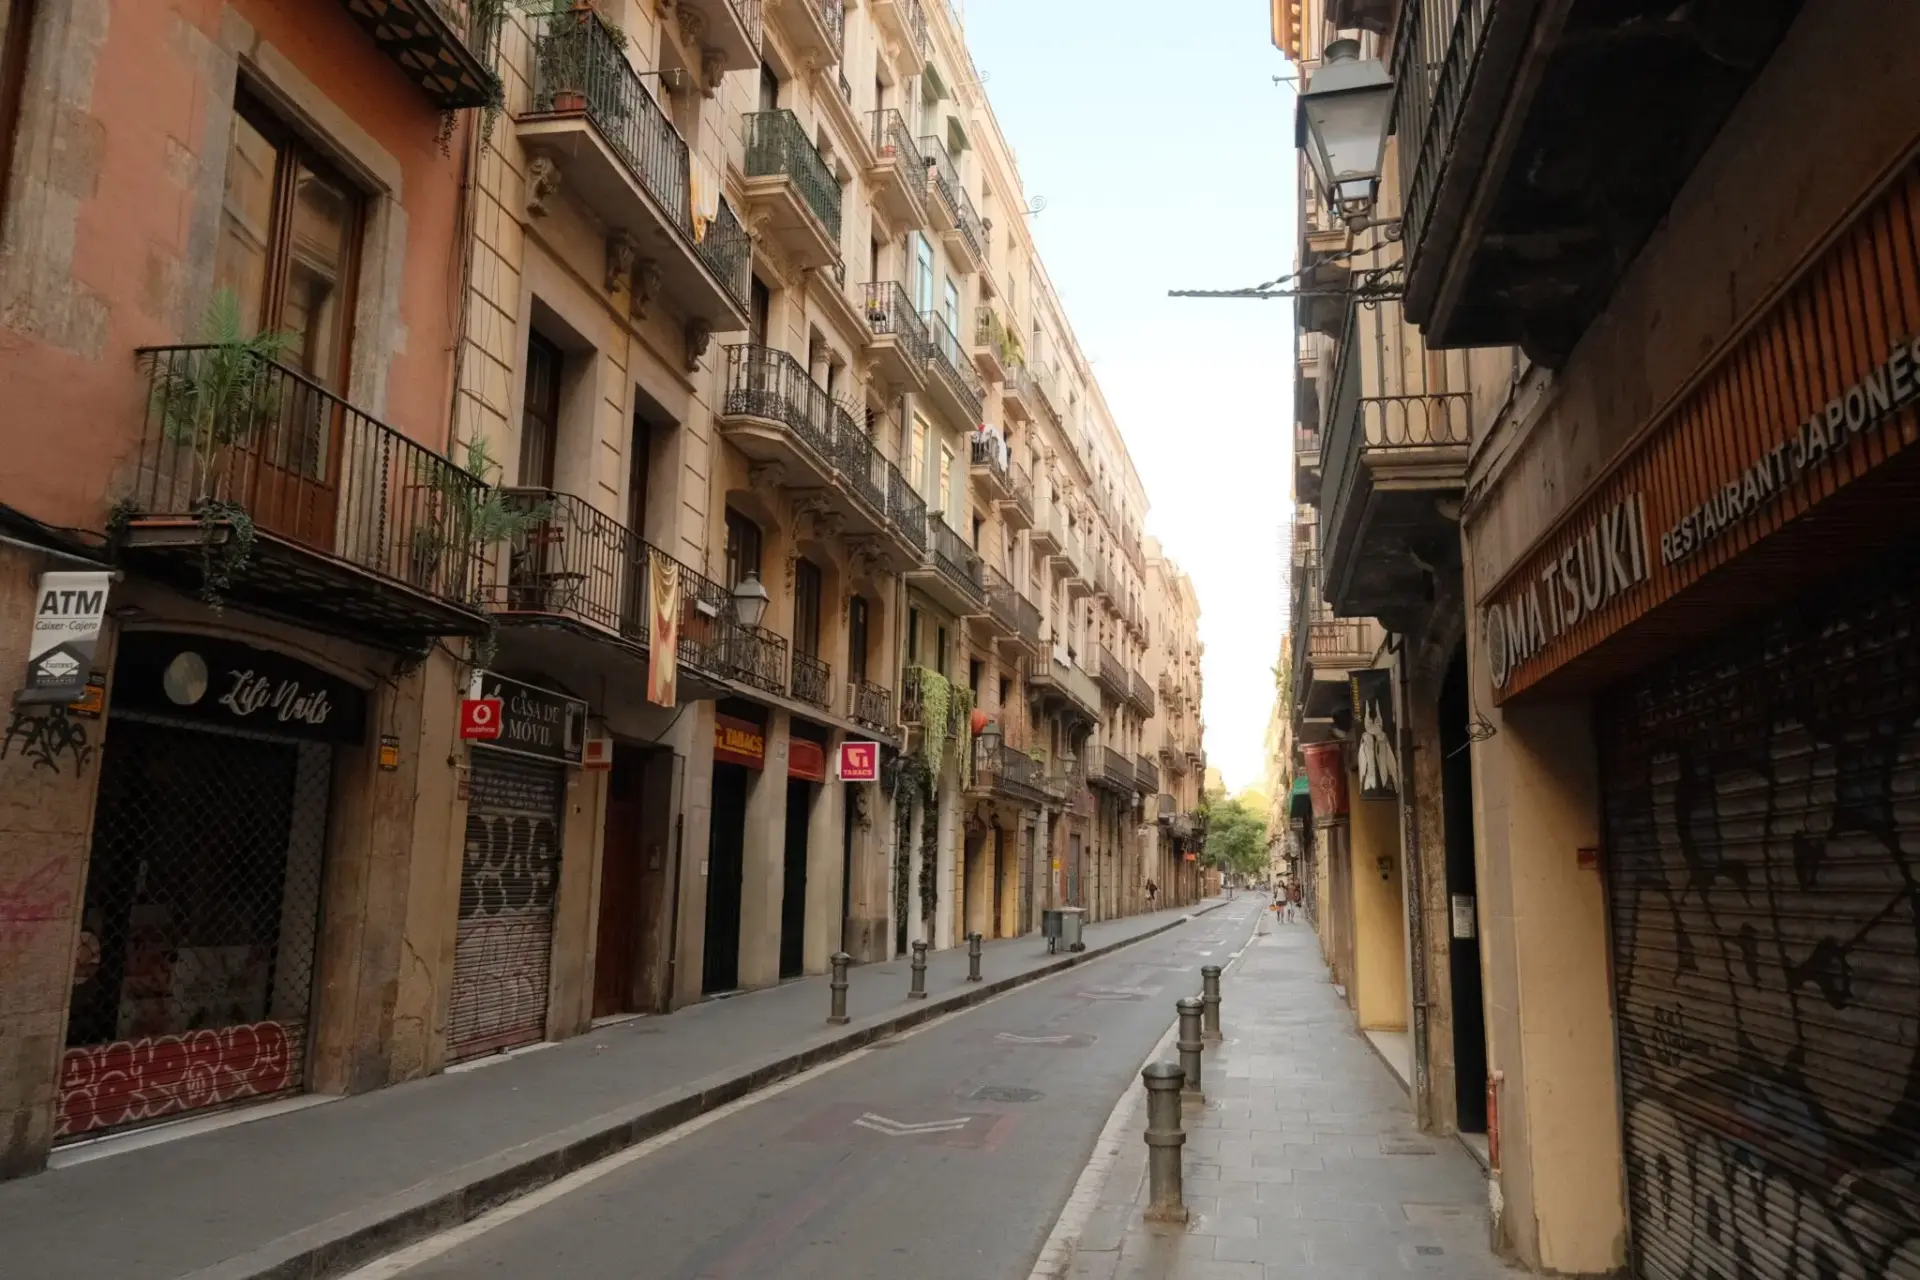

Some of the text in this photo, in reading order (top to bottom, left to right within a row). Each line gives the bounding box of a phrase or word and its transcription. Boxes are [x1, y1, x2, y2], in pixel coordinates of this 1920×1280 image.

[1660, 442, 1786, 566] RESTAURANT
[1506, 491, 1652, 668] MATSUKI
[39, 590, 104, 615] ATM
[217, 669, 332, 724] Lili Nails
[511, 695, 560, 724] CASA DE
[466, 725, 496, 733] vodafone
[725, 728, 763, 753] TABACS
